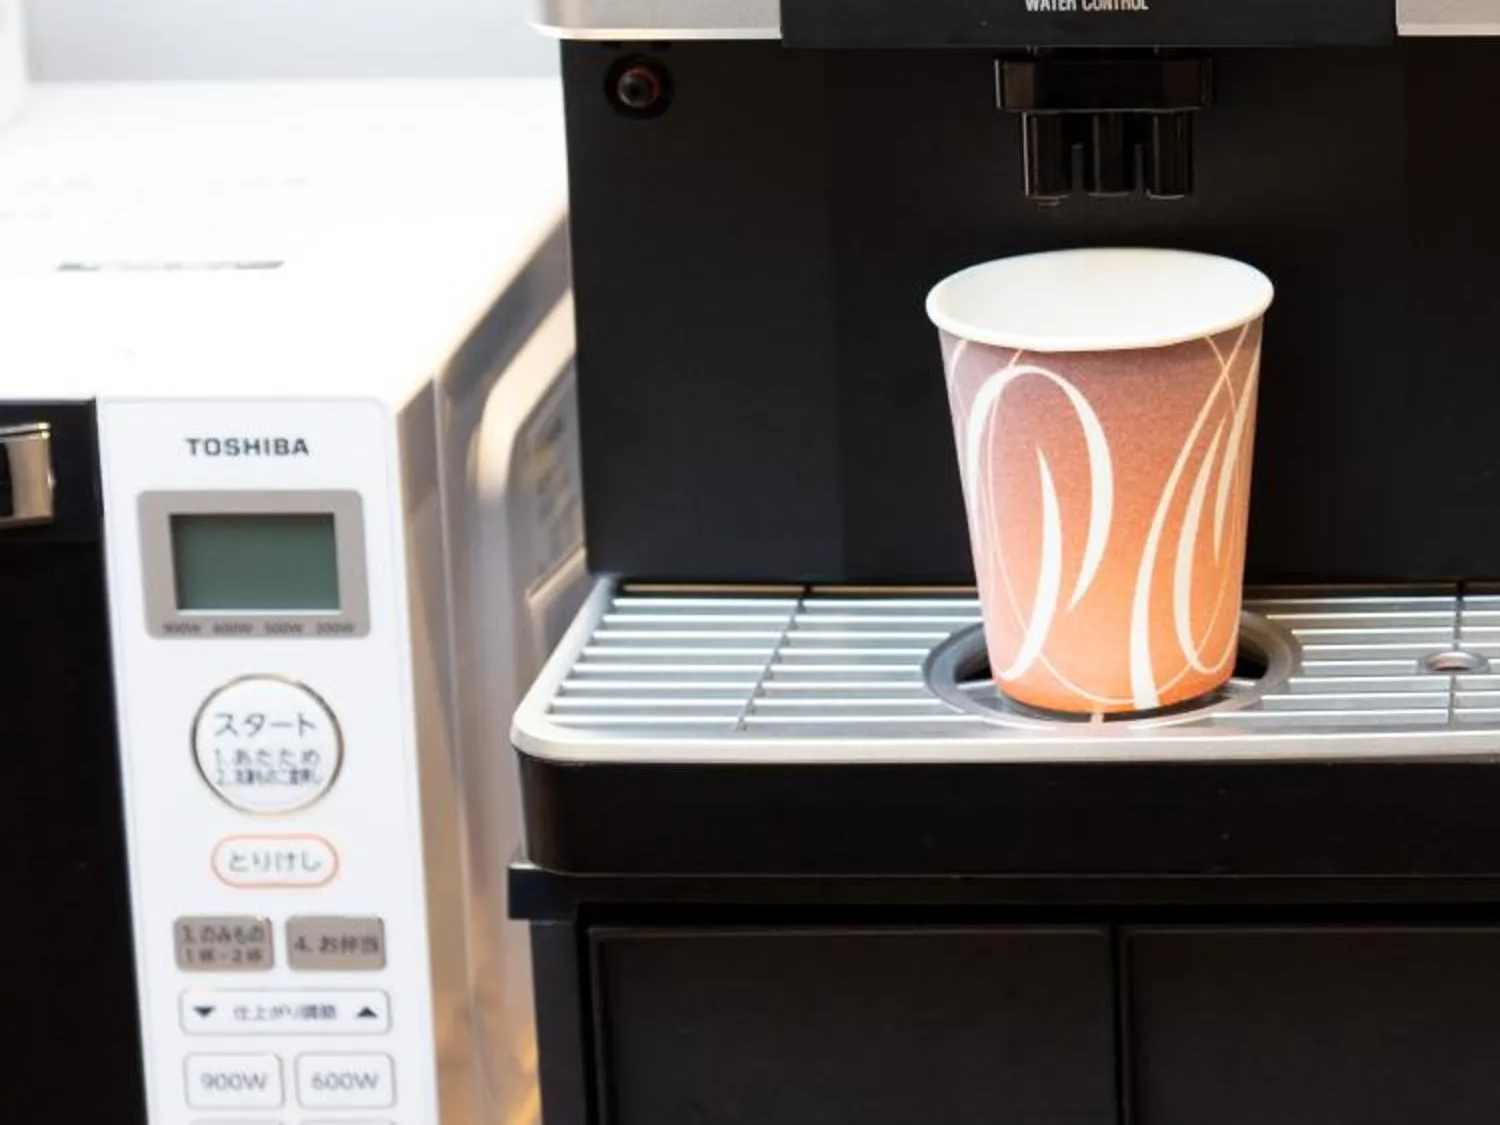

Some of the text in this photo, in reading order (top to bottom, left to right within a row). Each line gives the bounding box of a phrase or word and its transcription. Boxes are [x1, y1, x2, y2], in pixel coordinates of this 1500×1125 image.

[186, 437, 309, 457] TOSHIBA
[214, 712, 317, 737] スタート
[227, 850, 323, 873] とりけし
